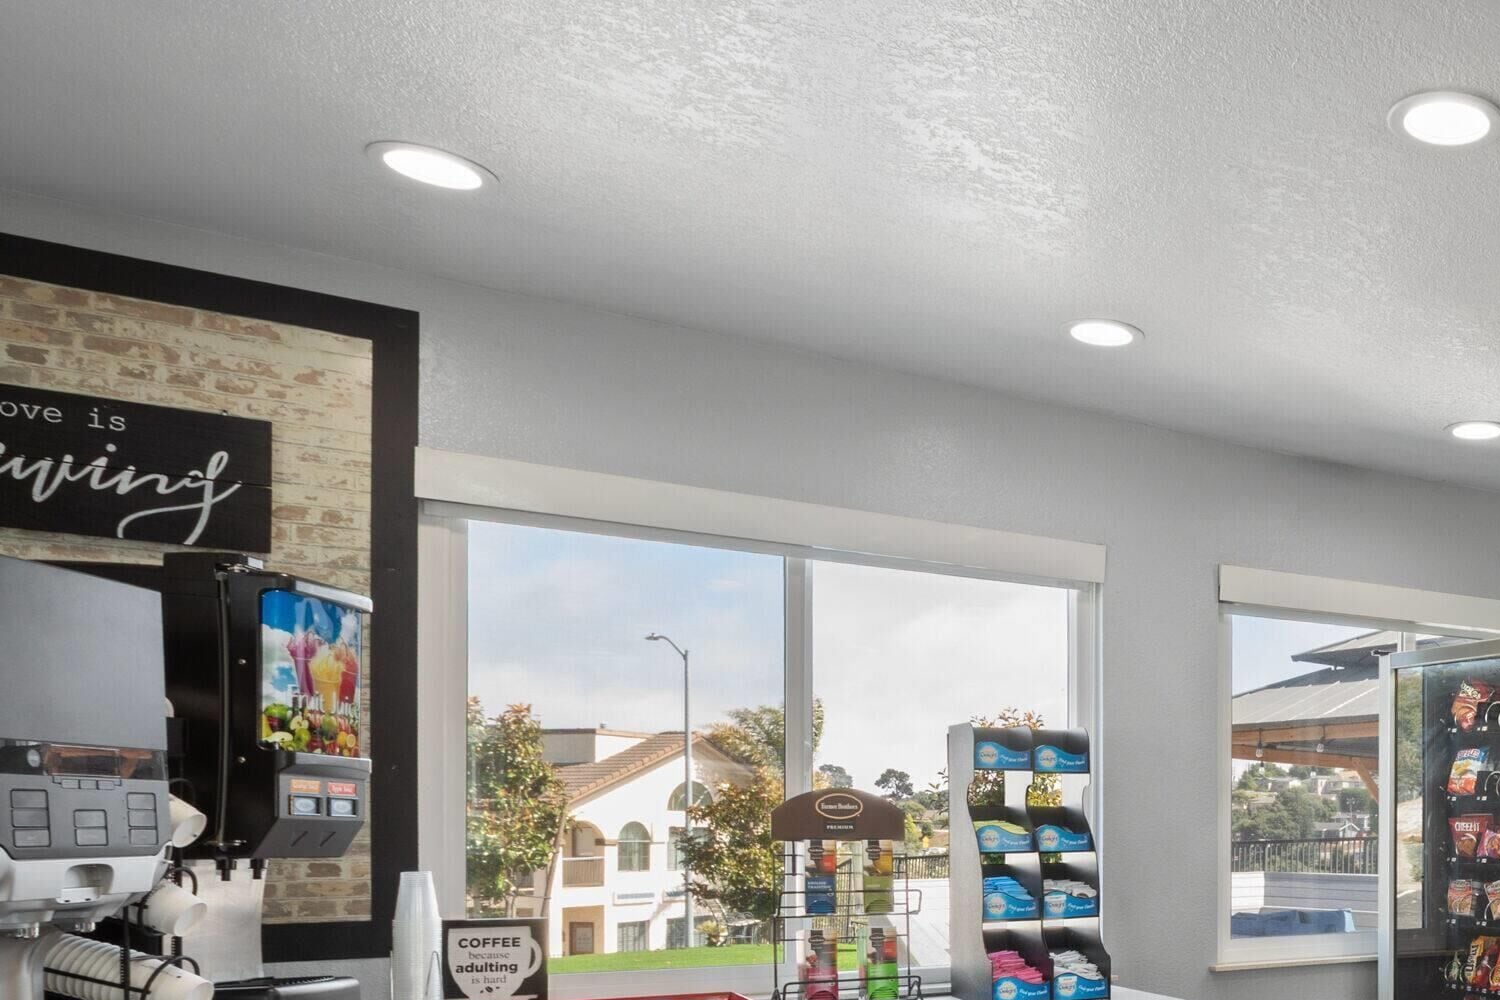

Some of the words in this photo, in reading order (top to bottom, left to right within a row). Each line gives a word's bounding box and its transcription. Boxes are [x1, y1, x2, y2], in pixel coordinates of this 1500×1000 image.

[88, 407, 127, 432] is
[458, 937, 521, 949] COFFEE
[468, 951, 510, 960] because
[455, 961, 519, 975] adulting
[471, 975, 480, 984] is
[483, 974, 507, 984] hard
